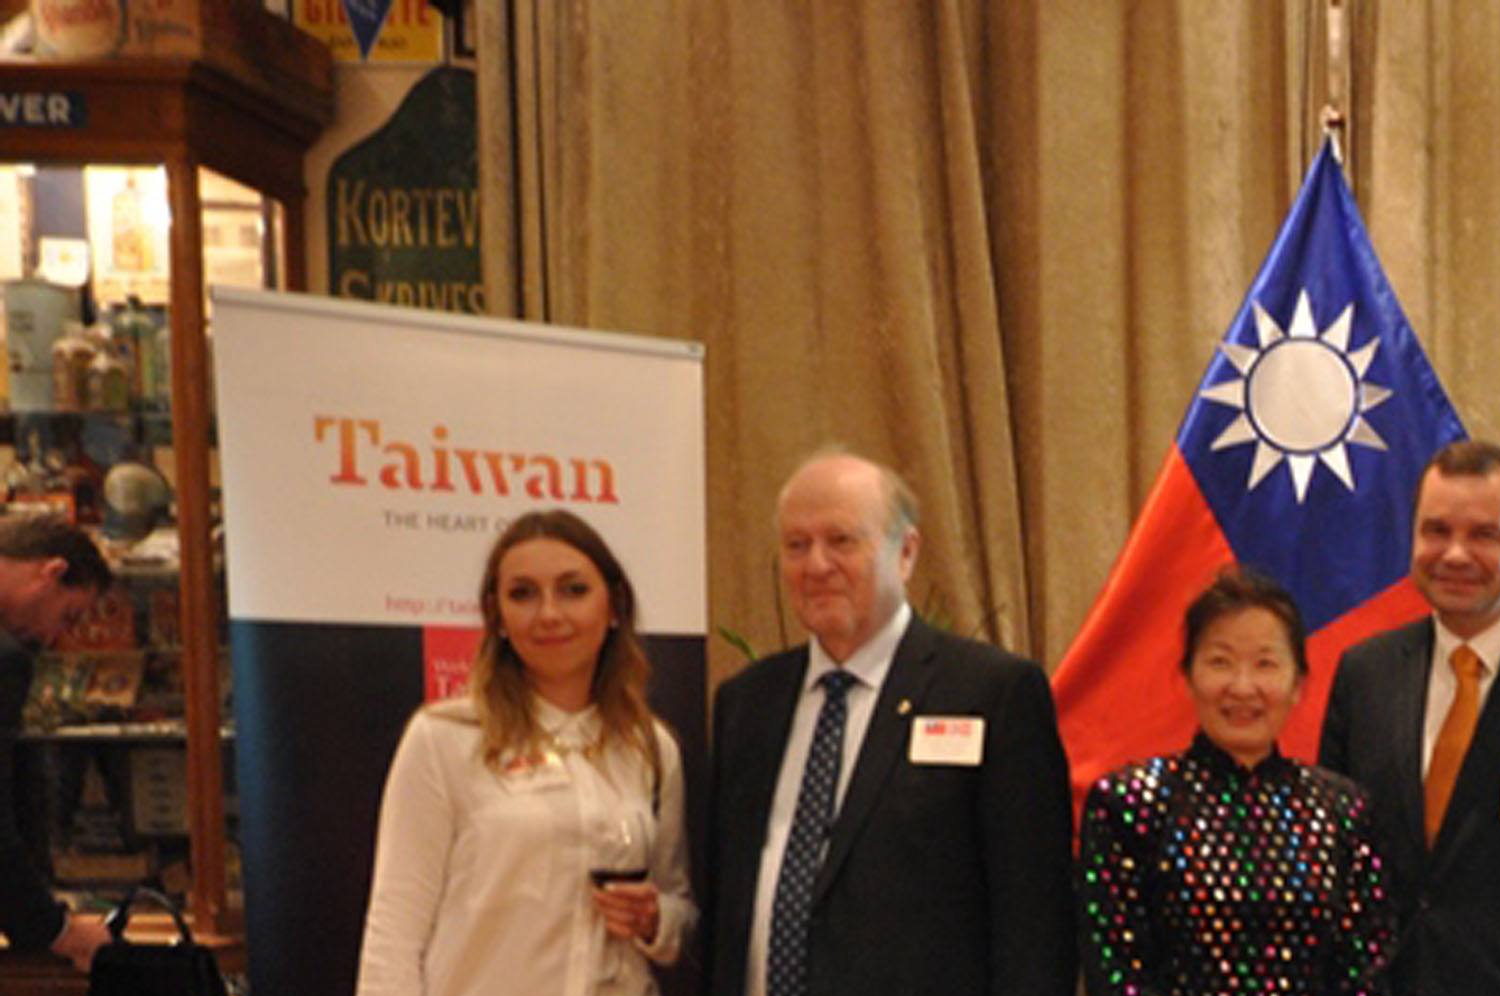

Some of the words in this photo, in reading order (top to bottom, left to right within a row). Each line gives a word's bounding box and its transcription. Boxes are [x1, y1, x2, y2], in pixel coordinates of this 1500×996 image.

[314, 415, 619, 504] Taiwan
[384, 511, 420, 529] THE
[427, 513, 490, 532] HEART
